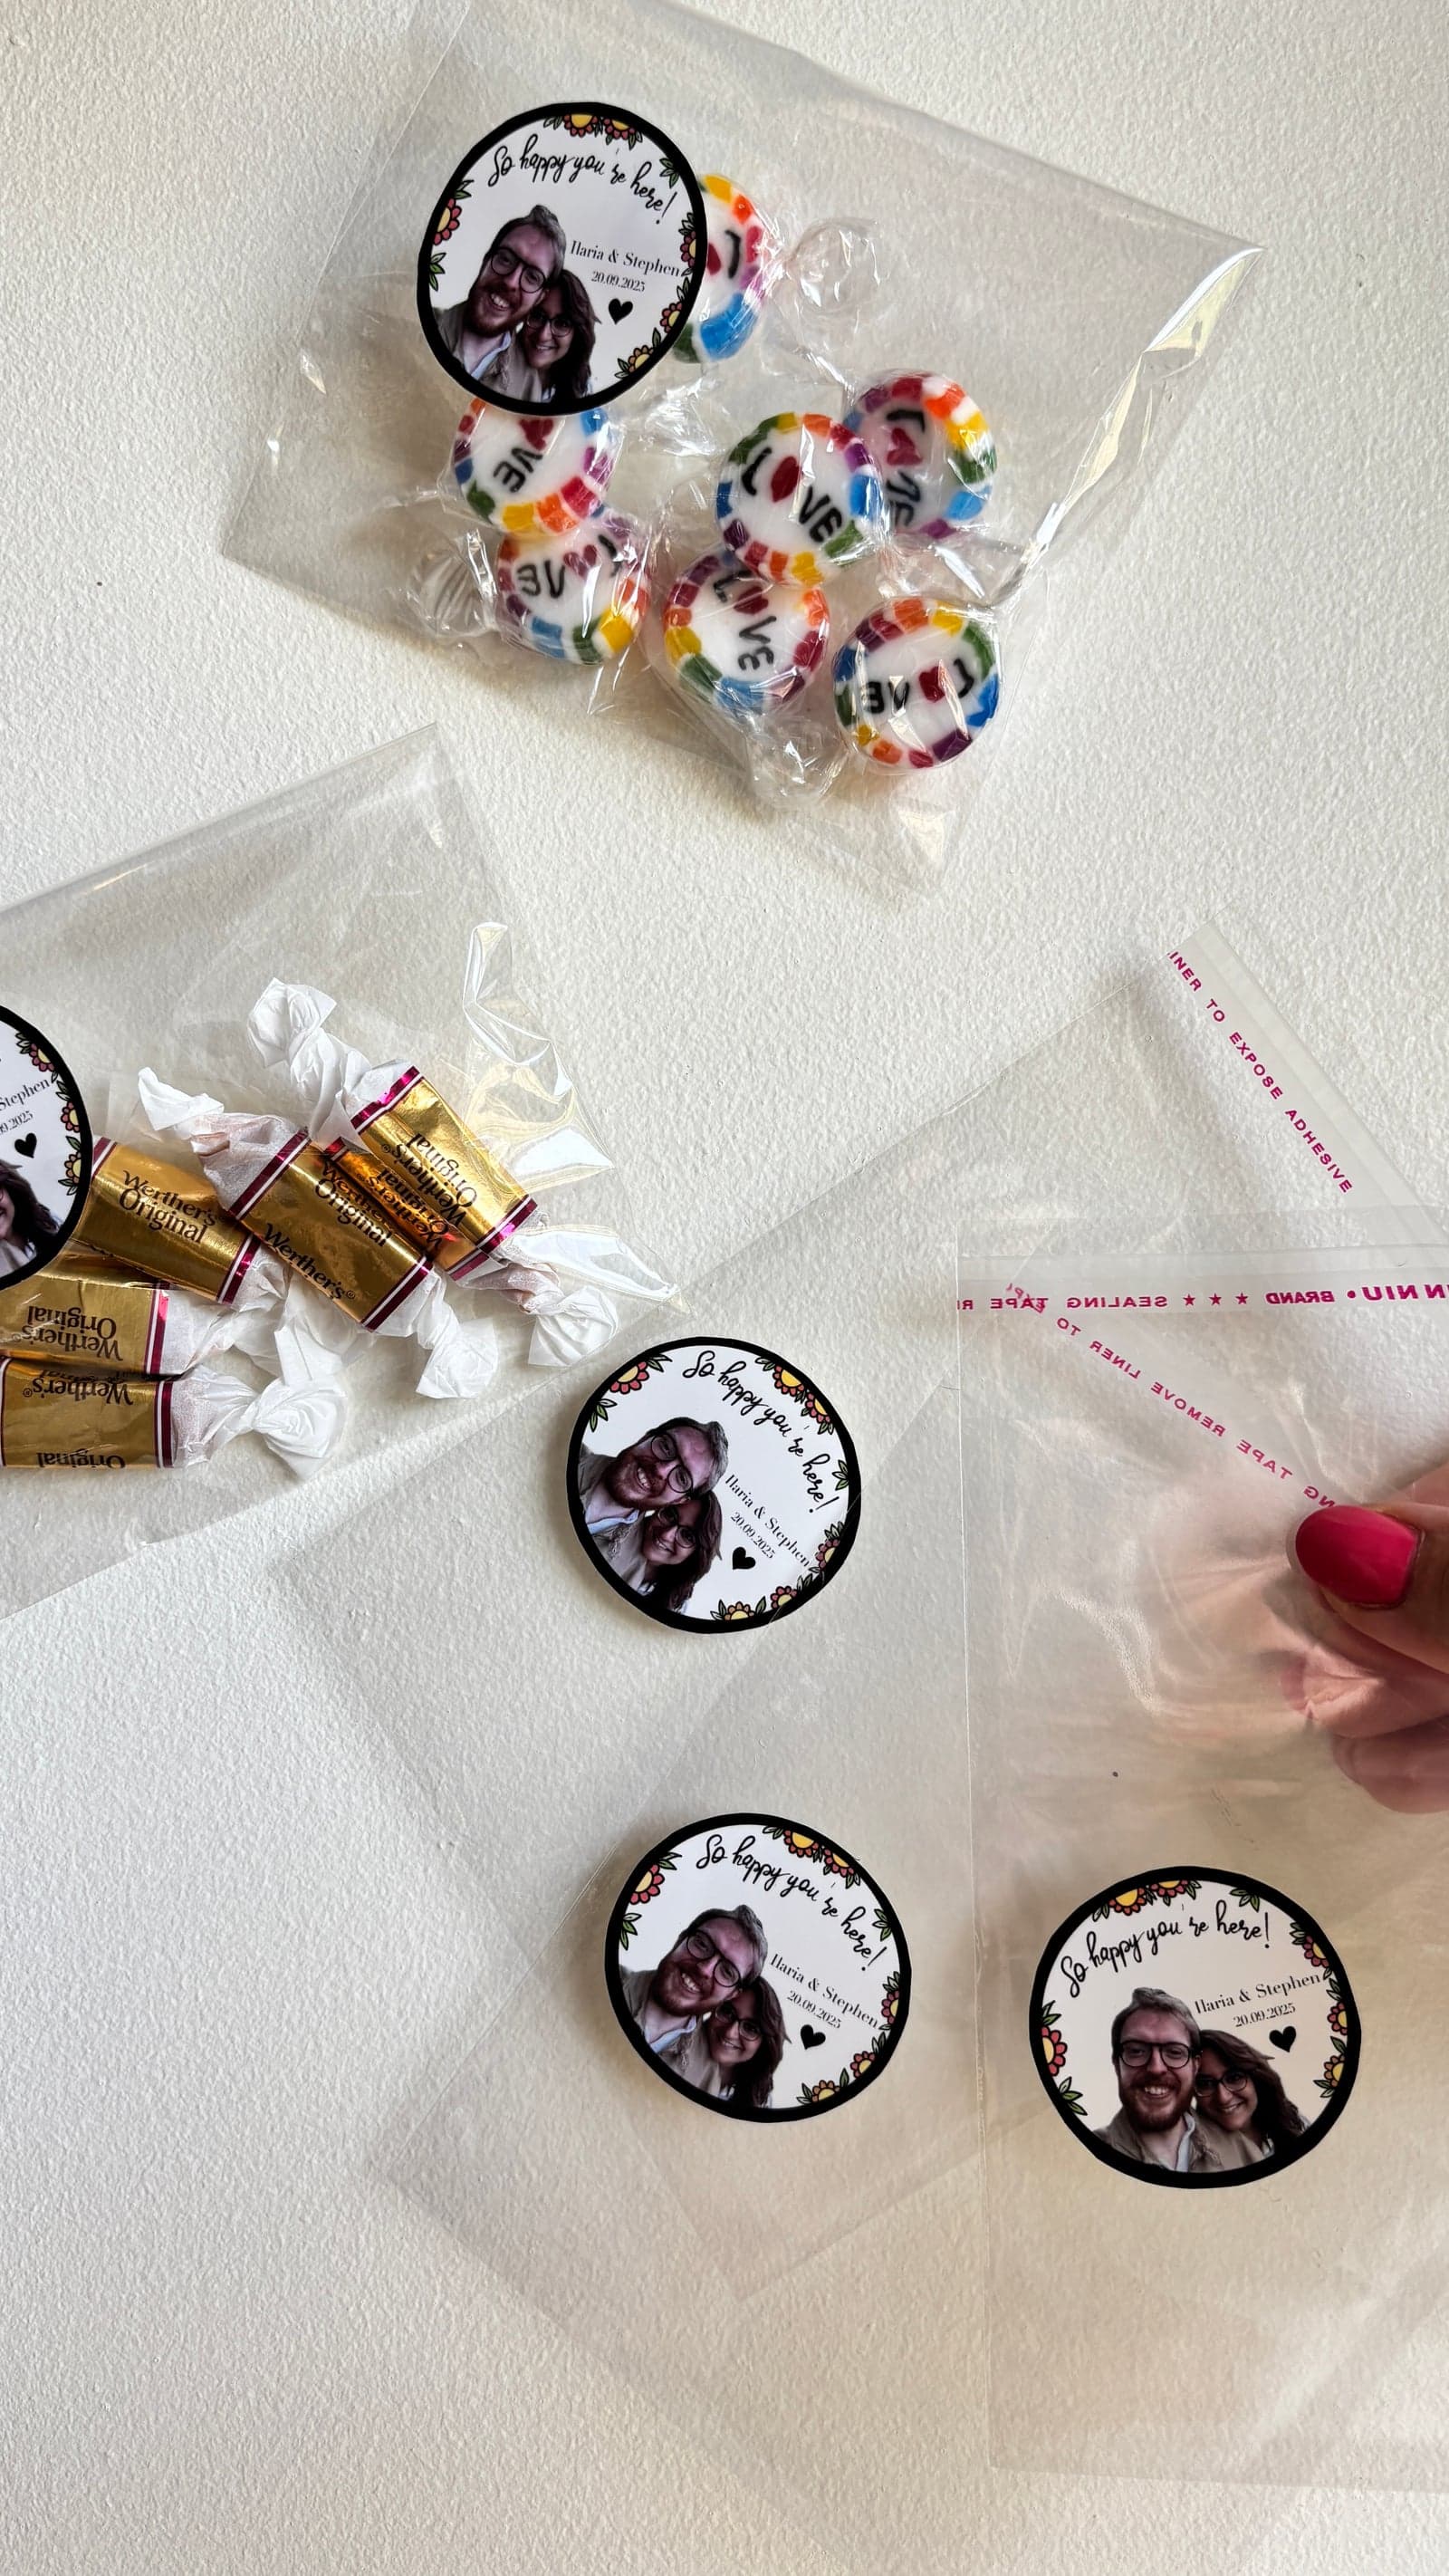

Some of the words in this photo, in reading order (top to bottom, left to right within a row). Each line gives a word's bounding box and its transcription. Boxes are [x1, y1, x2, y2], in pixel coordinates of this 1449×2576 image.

[488, 146, 515, 187] So
[519, 133, 574, 183] happy
[630, 161, 678, 225] here!
[570, 240, 604, 262] Ilaria
[608, 250, 619, 263] &
[626, 253, 680, 277] Stephen
[591, 271, 646, 293] 20.09.2025
[1167, 951, 1202, 992] INER
[1206, 998, 1225, 1023] TO
[1229, 1032, 1283, 1100] EXPOSE
[1285, 1109, 1352, 1193] ADHESIVE
[122, 1170, 217, 1227] Werther's
[377, 1169, 448, 1235] Original
[406, 1132, 479, 1211] Original
[119, 1187, 208, 1244] Original
[315, 1179, 391, 1247] Original
[27, 1305, 117, 1340] Original
[682, 1350, 715, 1379] So
[717, 1360, 765, 1416] happy
[802, 1453, 840, 1514] here!
[724, 1474, 754, 1510] Ilaria
[753, 1506, 765, 1519] &
[765, 1517, 810, 1568] Stephen
[730, 1511, 776, 1560] 20.09.2025
[696, 1834, 727, 1869] So
[733, 1836, 788, 1891] happy
[840, 1906, 888, 1972] here!
[1060, 1956, 1089, 1998] So
[1086, 1931, 1147, 1973] happy
[1215, 1899, 1270, 1949] here!
[770, 1953, 804, 1985] Ilaria
[808, 1978, 820, 1991] &
[822, 1985, 880, 2029] Stephen
[786, 1989, 842, 2030] 20.09.2025
[1195, 1996, 1234, 2015] Ilaria
[1239, 1988, 1251, 2002] &
[1255, 1974, 1321, 2000] Stephen
[1233, 2003, 1296, 2028] 20.09.2025
